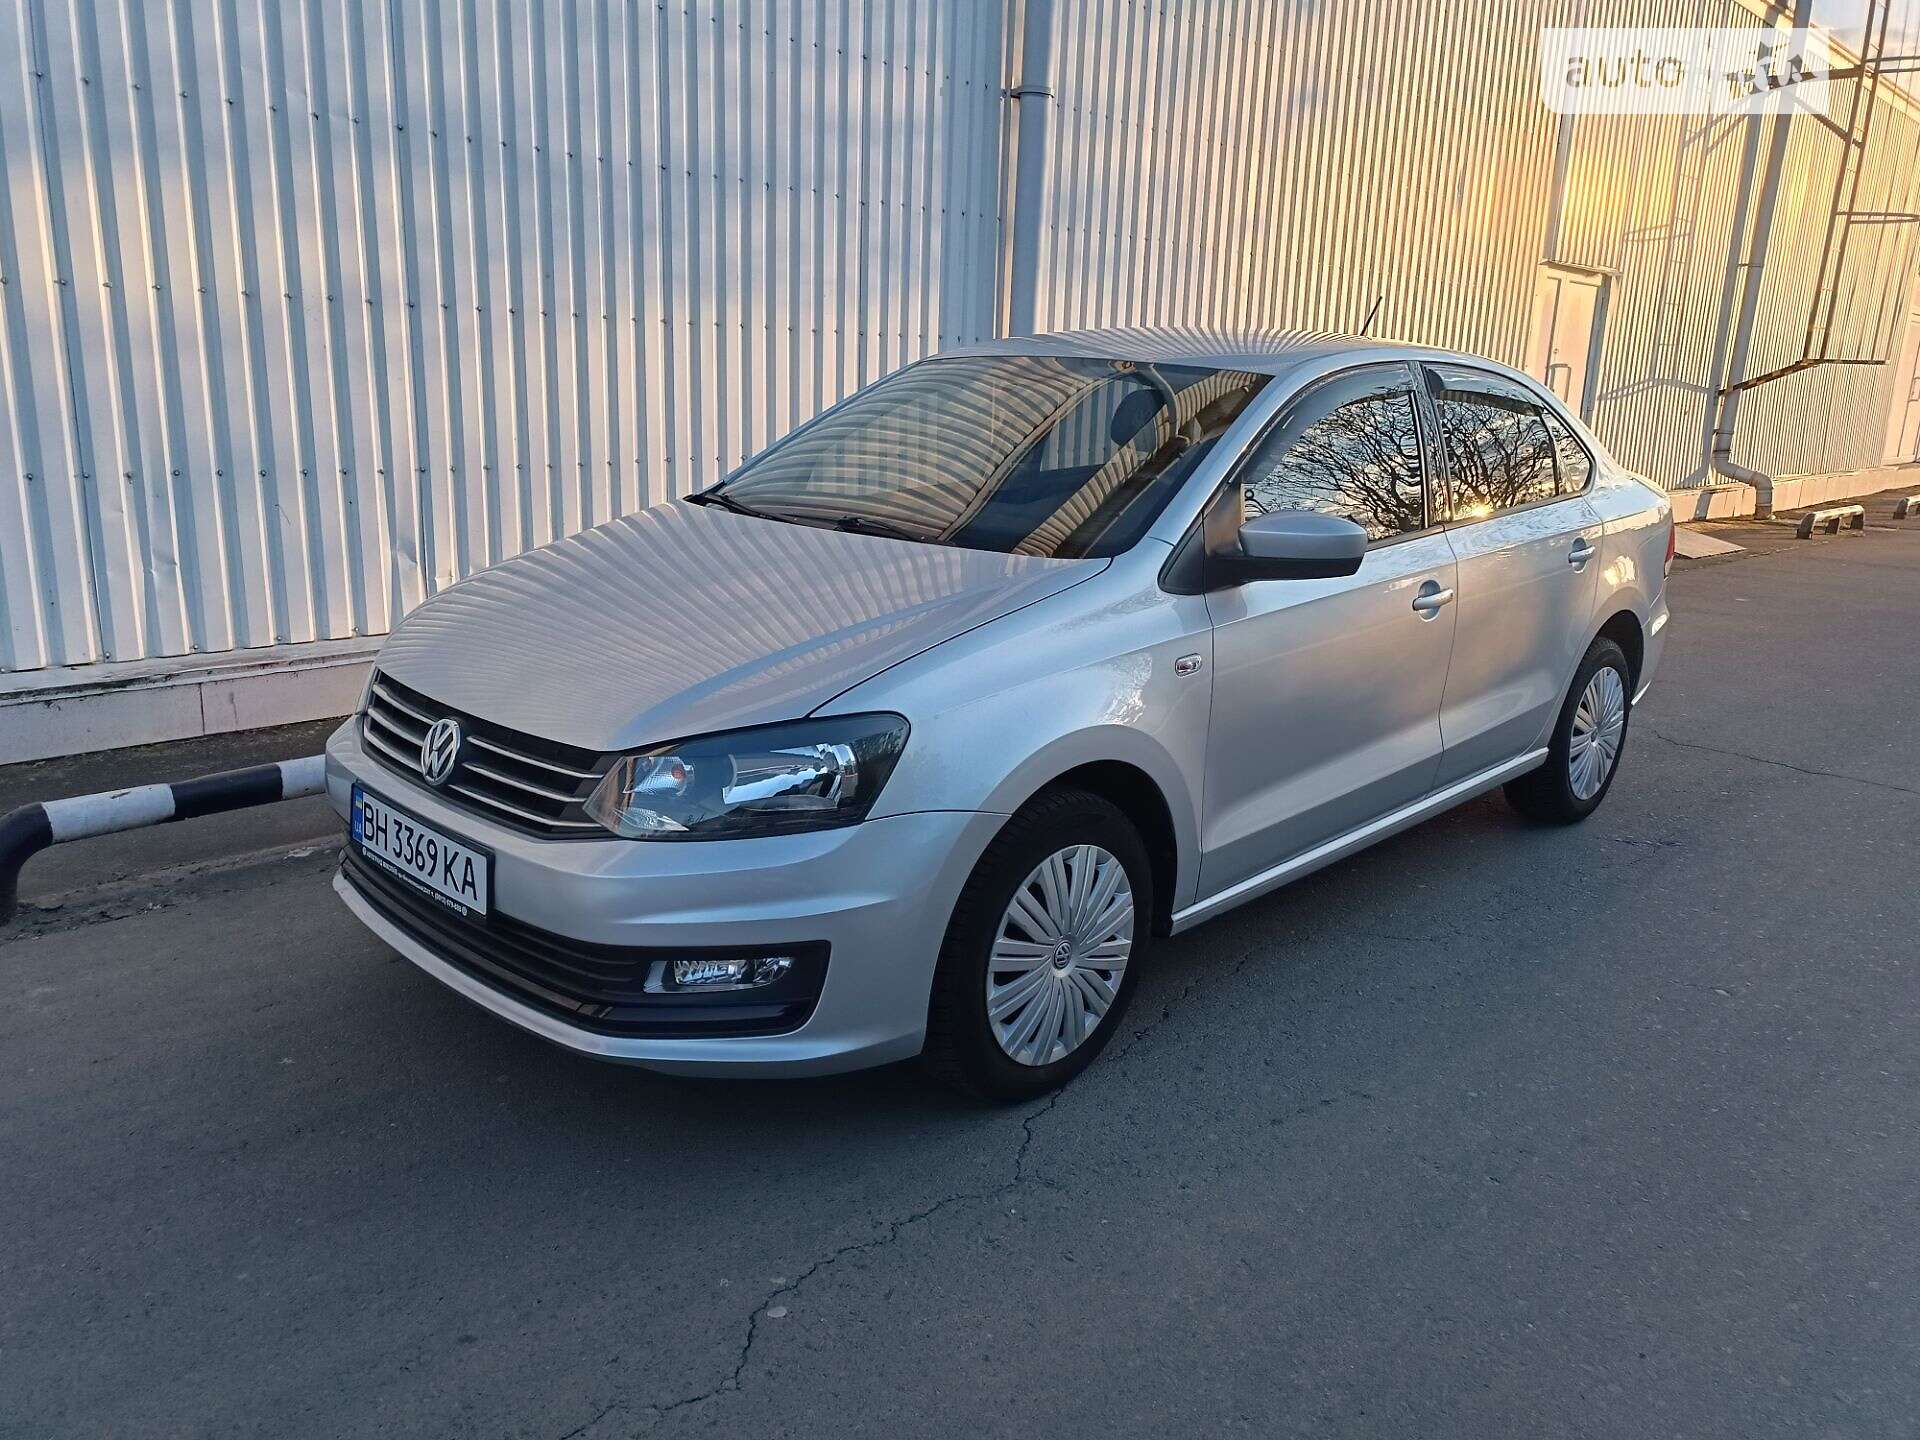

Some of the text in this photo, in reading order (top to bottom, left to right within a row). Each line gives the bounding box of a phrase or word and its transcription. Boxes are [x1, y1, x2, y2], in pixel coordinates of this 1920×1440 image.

[364, 801, 388, 851] BH
[393, 819, 438, 877] 3369
[444, 845, 478, 901] KA
